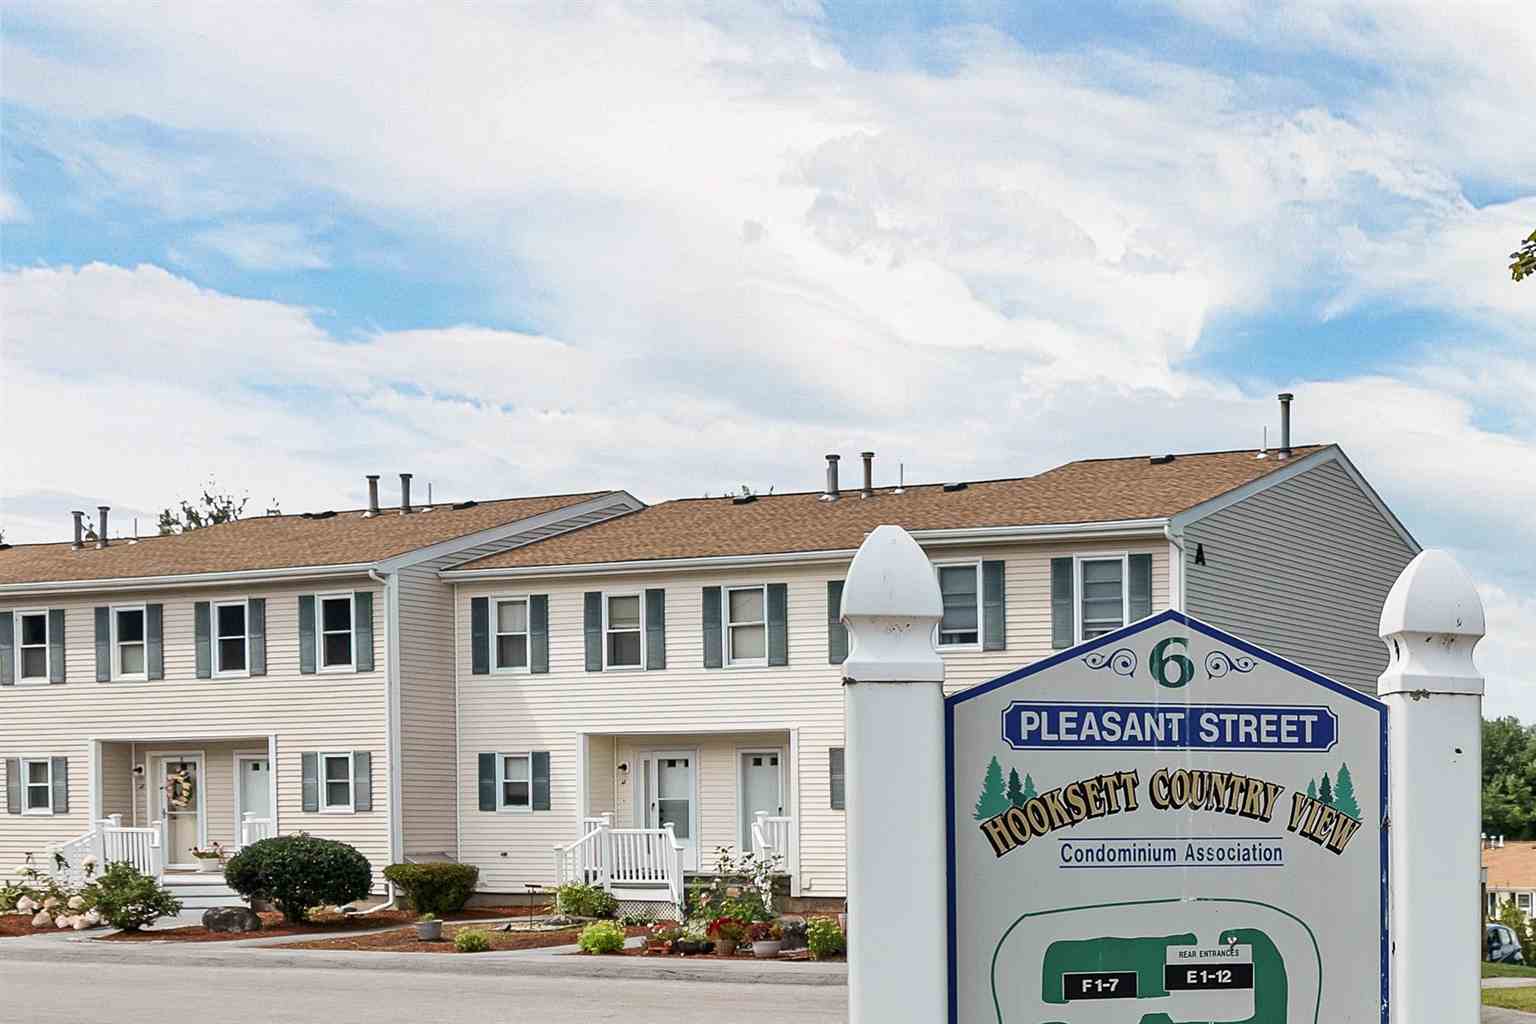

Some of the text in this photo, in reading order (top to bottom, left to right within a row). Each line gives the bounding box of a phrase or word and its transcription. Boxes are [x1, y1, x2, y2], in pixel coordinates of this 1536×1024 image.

[1148, 637, 1195, 688] 6
[1020, 711, 1319, 743] PLEASANT STREET
[980, 768, 1362, 857] HOOKSETT COUNTRY VIEW
[1060, 843, 1283, 863] Condominium Association
[1178, 949, 1240, 958] REAR ENTRANCES
